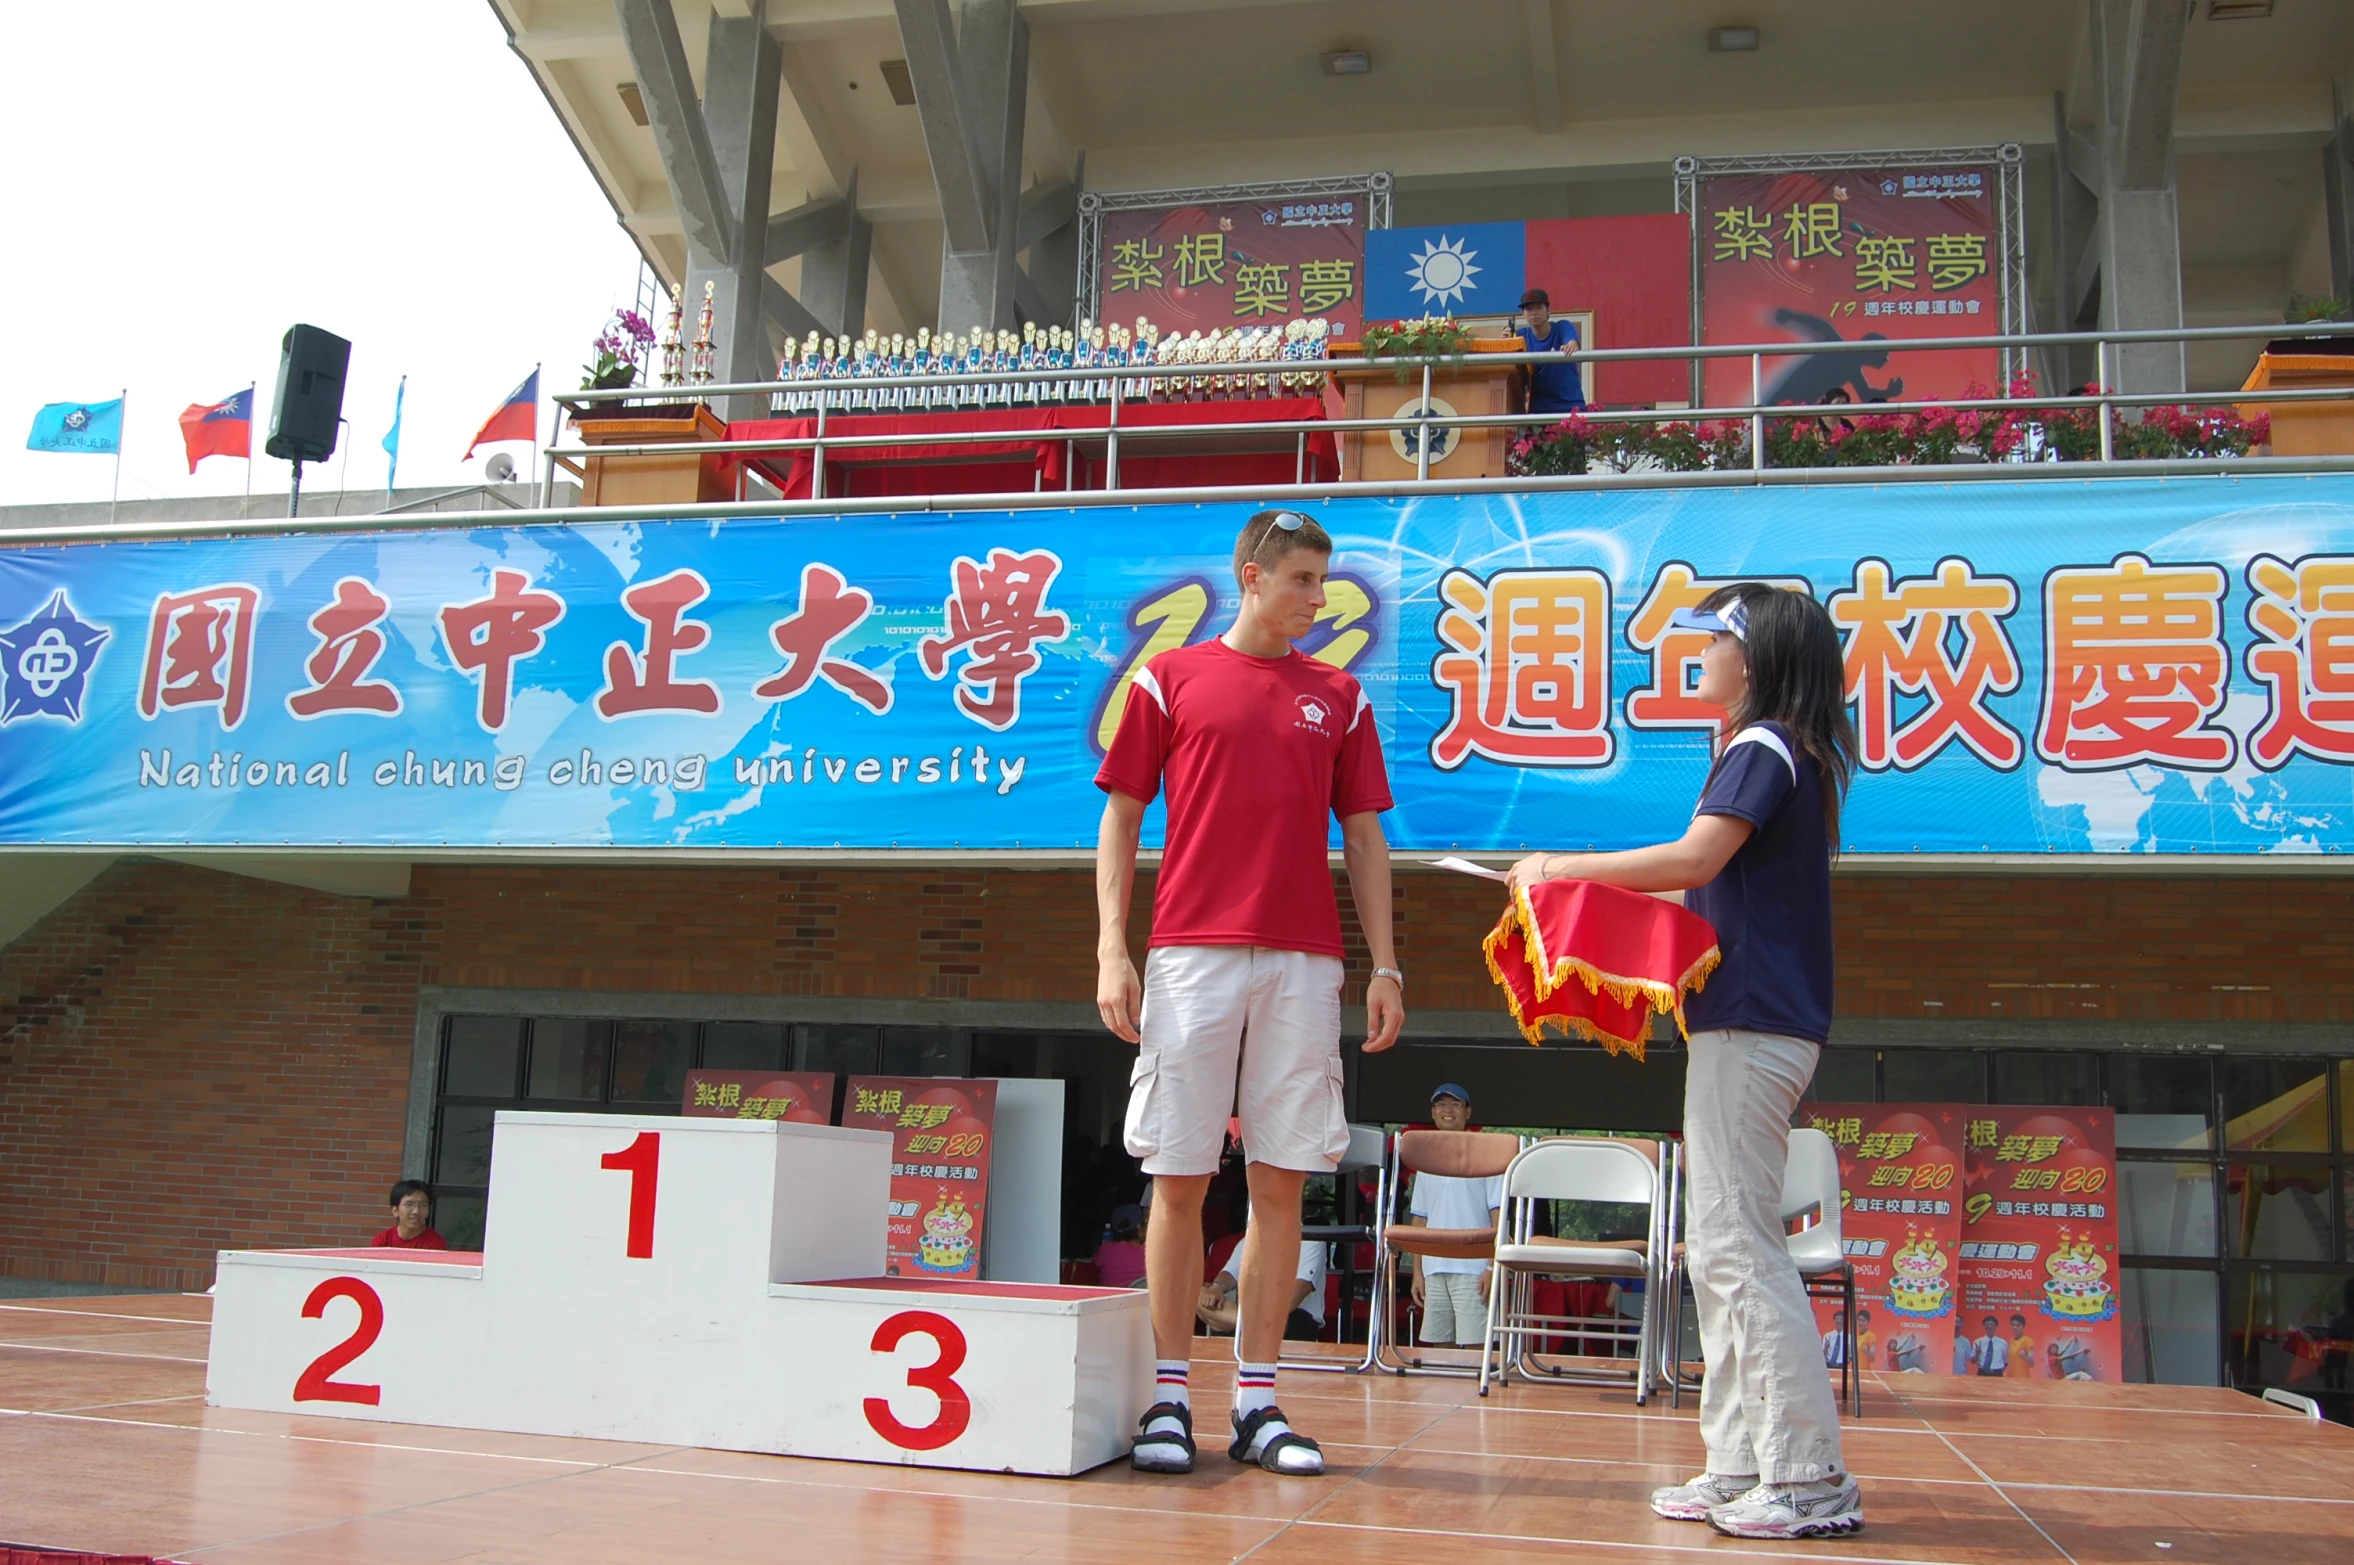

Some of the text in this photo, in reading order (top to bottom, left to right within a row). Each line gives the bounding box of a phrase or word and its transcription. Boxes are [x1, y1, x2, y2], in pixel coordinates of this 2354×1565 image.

[1713, 203, 1988, 292] 紮根 築夢
[1111, 233, 1356, 316] 紮根 築夢
[1829, 300, 1981, 318] 19 週年校慶運動會
[137, 548, 1071, 732] 國立中正大學
[140, 745, 1027, 796] National chung cheng university
[694, 1083, 741, 1107] 紮根
[855, 1089, 953, 1129] 紮根 築夢
[904, 1133, 983, 1157] 迎向 20
[1857, 1132, 1919, 1160] 築夢
[1964, 1119, 2063, 1162] 根 築夢
[601, 1132, 659, 1259] 1
[1867, 1163, 1954, 1190] 迎向 20
[2009, 1166, 2107, 1193] 迎向 20
[1853, 1198, 1950, 1215] 週年校慶活動
[1996, 1201, 2105, 1219] 週年校慶活動
[293, 1276, 384, 1407] 2
[863, 1311, 972, 1450] 3
